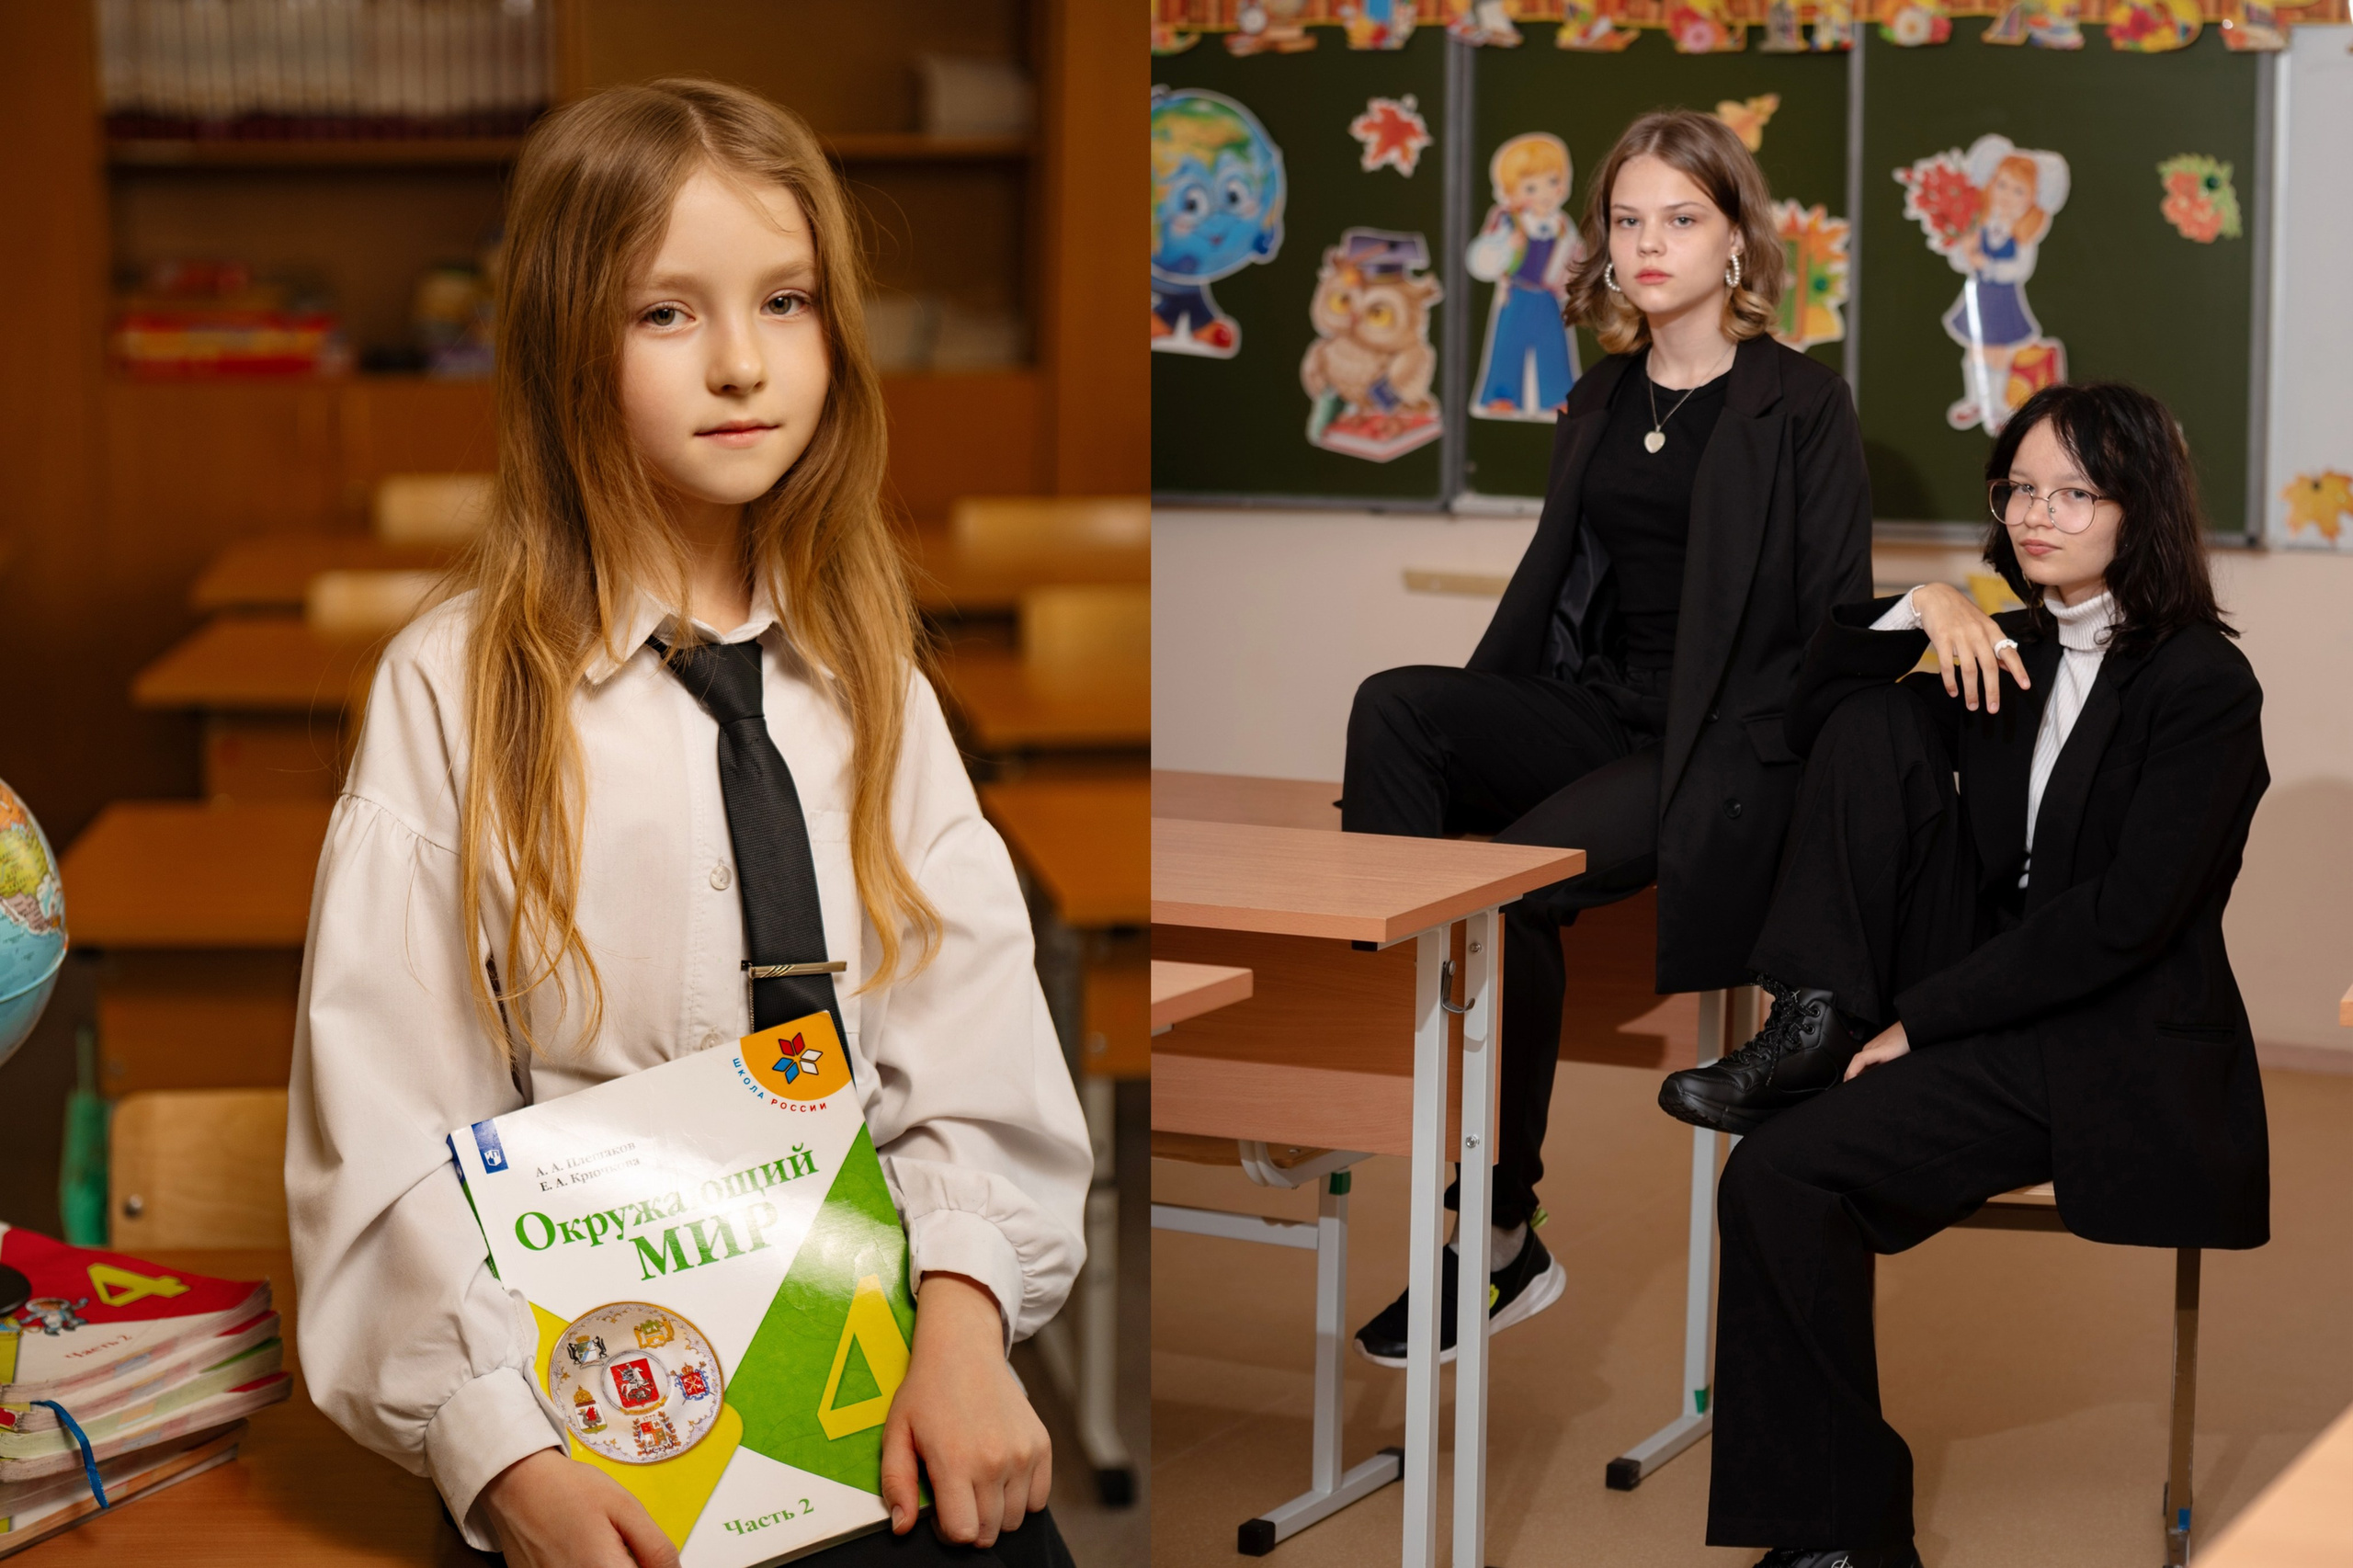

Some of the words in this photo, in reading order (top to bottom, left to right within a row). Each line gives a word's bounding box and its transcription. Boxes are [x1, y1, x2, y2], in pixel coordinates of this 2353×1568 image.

[733, 1057, 765, 1099] ШКОЛА
[770, 1098, 827, 1113] РОССИИ
[535, 1166, 549, 1178] А.
[551, 1162, 564, 1174] А.
[539, 1181, 553, 1192] Е.
[555, 1177, 569, 1188] А.
[628, 1200, 779, 1281] МИР
[86, 1262, 192, 1308] 4
[722, 1509, 796, 1537] Часть
[798, 1497, 815, 1516] 2
